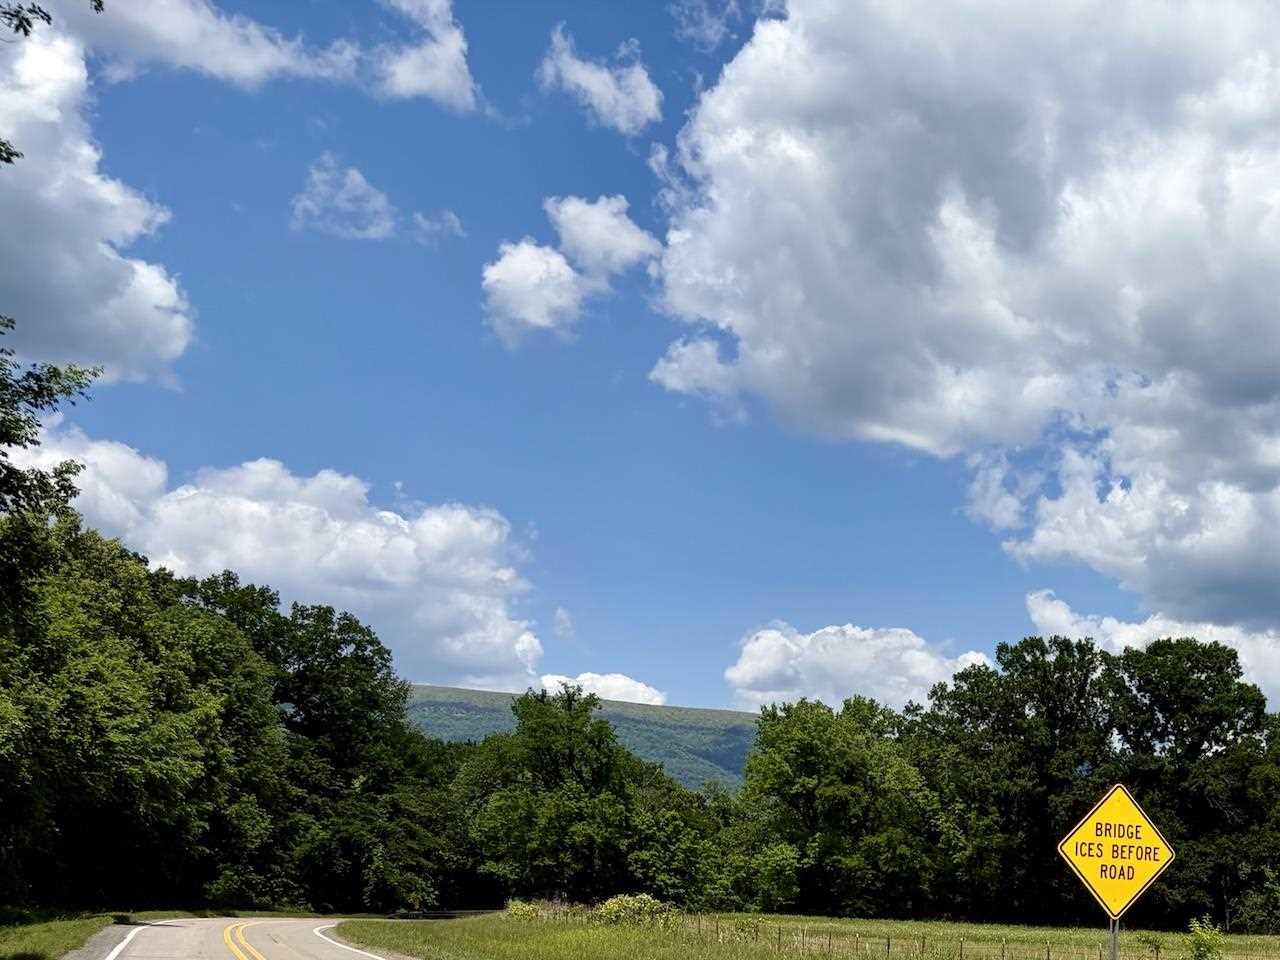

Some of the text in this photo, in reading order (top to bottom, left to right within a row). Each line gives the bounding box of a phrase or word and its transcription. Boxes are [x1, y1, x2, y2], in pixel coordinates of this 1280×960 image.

[1095, 822, 1142, 840] BRIDGE
[1075, 841, 1160, 862] ICES BEFORE
[1100, 864, 1135, 880] ROAD
